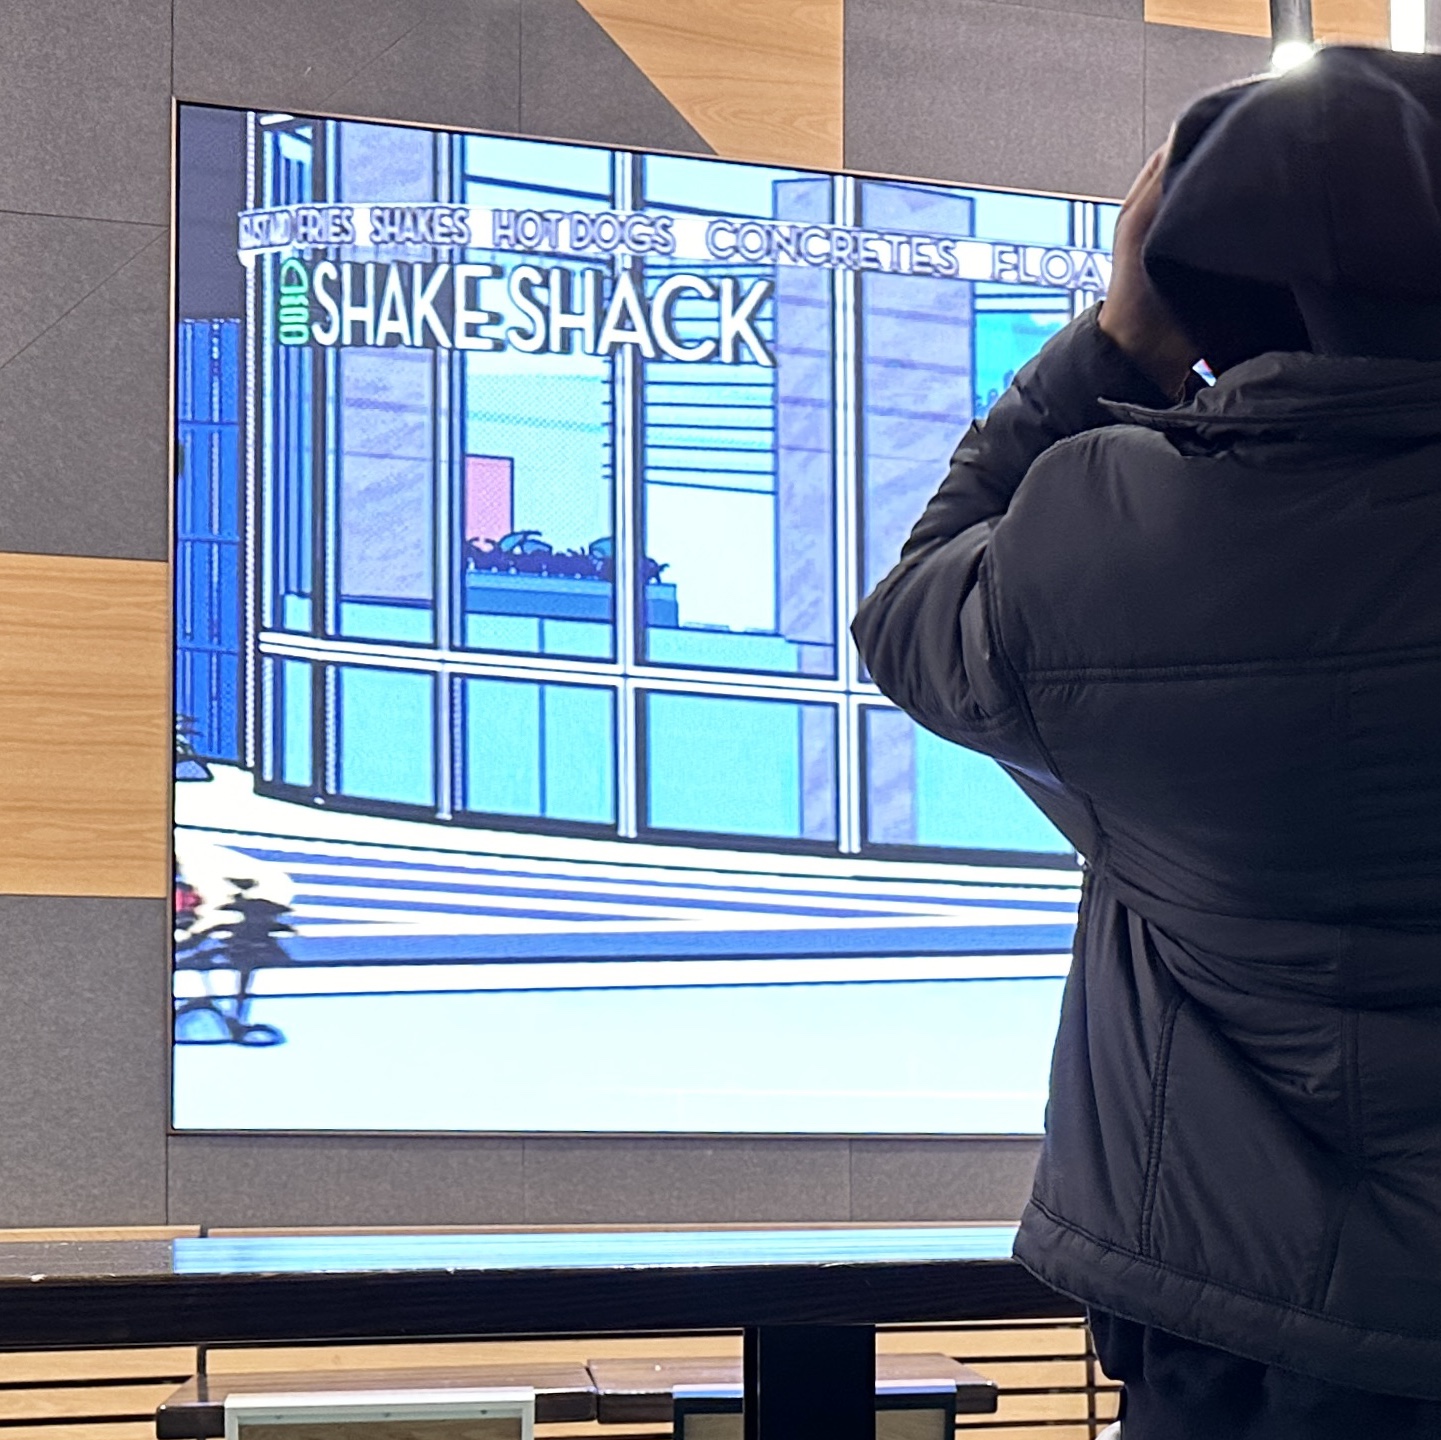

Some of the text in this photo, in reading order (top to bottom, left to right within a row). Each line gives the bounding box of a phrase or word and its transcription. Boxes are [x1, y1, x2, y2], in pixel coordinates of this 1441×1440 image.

[297, 206, 356, 244] FRIES
[370, 206, 471, 245] SHAKES
[705, 219, 960, 276] CONCRETES
[990, 244, 1112, 296] FLOA
[311, 261, 776, 367] SHAKE SHACK
